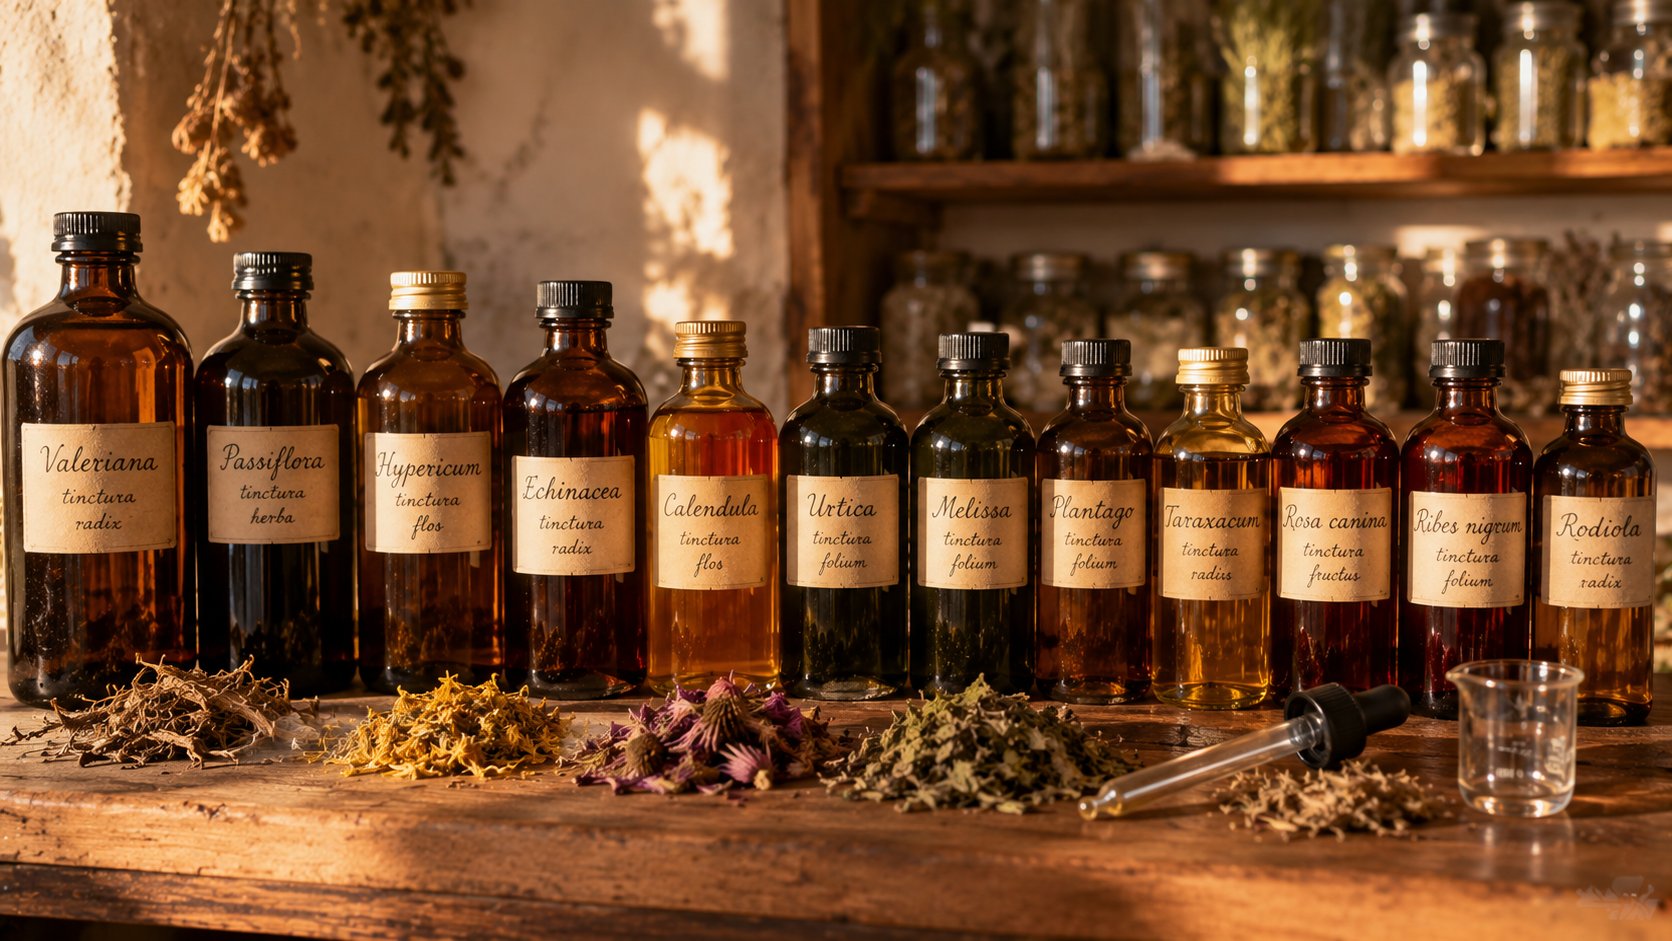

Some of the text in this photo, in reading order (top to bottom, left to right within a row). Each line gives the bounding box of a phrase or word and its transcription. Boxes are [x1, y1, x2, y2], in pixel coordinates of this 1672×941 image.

[40, 443, 159, 473] Valeriana
[220, 443, 325, 481] Passiflora
[376, 451, 482, 488] Hypericum
[63, 487, 136, 505] tinctura
[241, 484, 306, 500] tinctura
[524, 475, 622, 500] Echinacea
[396, 492, 461, 507] tinctura
[664, 492, 759, 517] Calendula
[808, 493, 877, 517] Urtica
[932, 495, 1012, 519] Melissa
[76, 513, 123, 530] radix
[251, 508, 296, 525] herba
[540, 515, 604, 530] tinctura
[1051, 494, 1134, 529] Plantago
[1165, 504, 1260, 529] Taraxacum
[1283, 504, 1387, 532] Rosa canina
[413, 515, 444, 539] flos
[813, 531, 872, 545] tinctura
[1414, 508, 1523, 545] Ribes nigrum
[1557, 512, 1642, 542] Rodiola
[553, 540, 593, 555] radix
[681, 531, 741, 546] tinctura
[944, 532, 1002, 547] tinctura
[1065, 532, 1122, 547] tinctura
[1183, 542, 1239, 557] tinctura
[1304, 543, 1365, 558] tinctura
[1437, 547, 1500, 563] tinctura
[1571, 550, 1632, 565] tinctura
[695, 553, 723, 577] flos
[821, 553, 868, 576] folium
[952, 553, 998, 577] folium
[1073, 553, 1118, 576] folium
[1309, 564, 1361, 588] fructus
[1444, 570, 1493, 594] folium
[1581, 573, 1622, 588] radix
